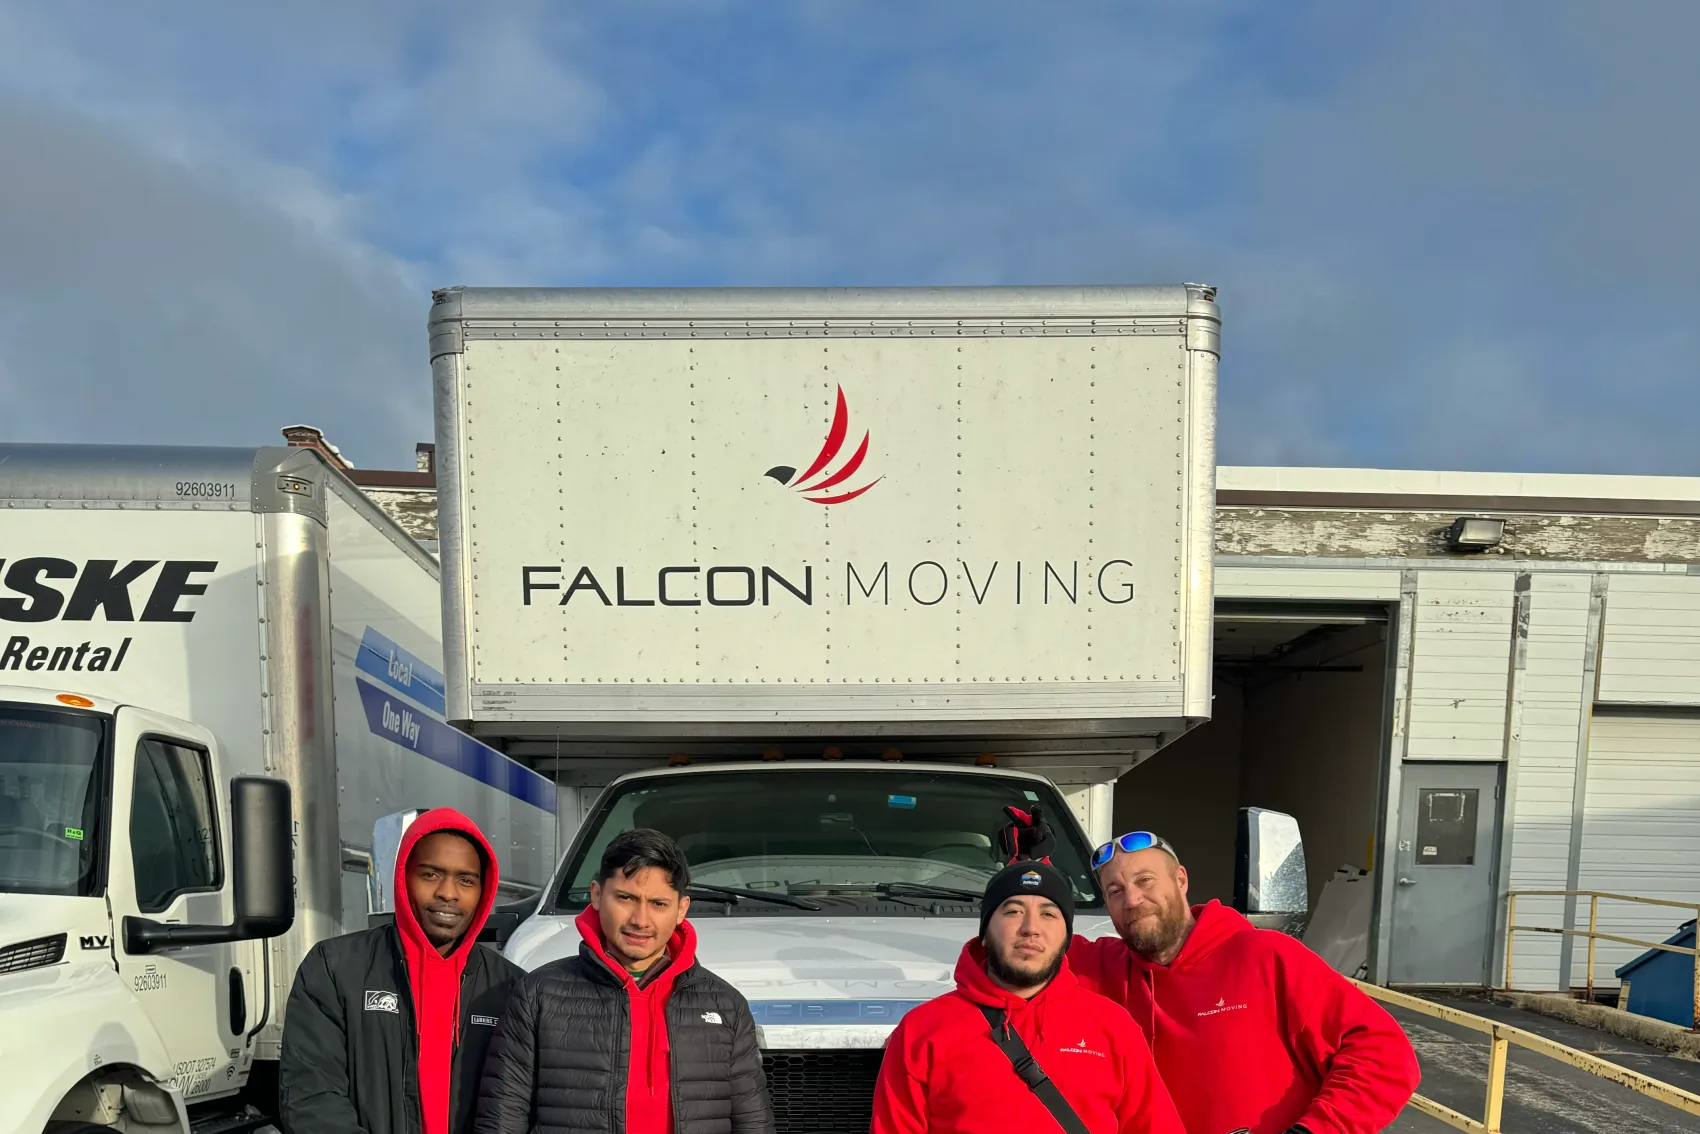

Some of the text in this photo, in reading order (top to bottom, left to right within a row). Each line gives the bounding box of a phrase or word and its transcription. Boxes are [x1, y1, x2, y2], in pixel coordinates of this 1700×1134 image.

[175, 482, 235, 497] 92603911
[0, 557, 219, 623] SKE
[522, 560, 1134, 606] FALCON MOVING
[0, 636, 133, 672] Rental
[388, 650, 413, 687] Local
[382, 701, 420, 748] One Way
[80, 935, 108, 950] MV
[134, 974, 167, 991] 92603911
[1220, 1003, 1248, 1012] MOVING
